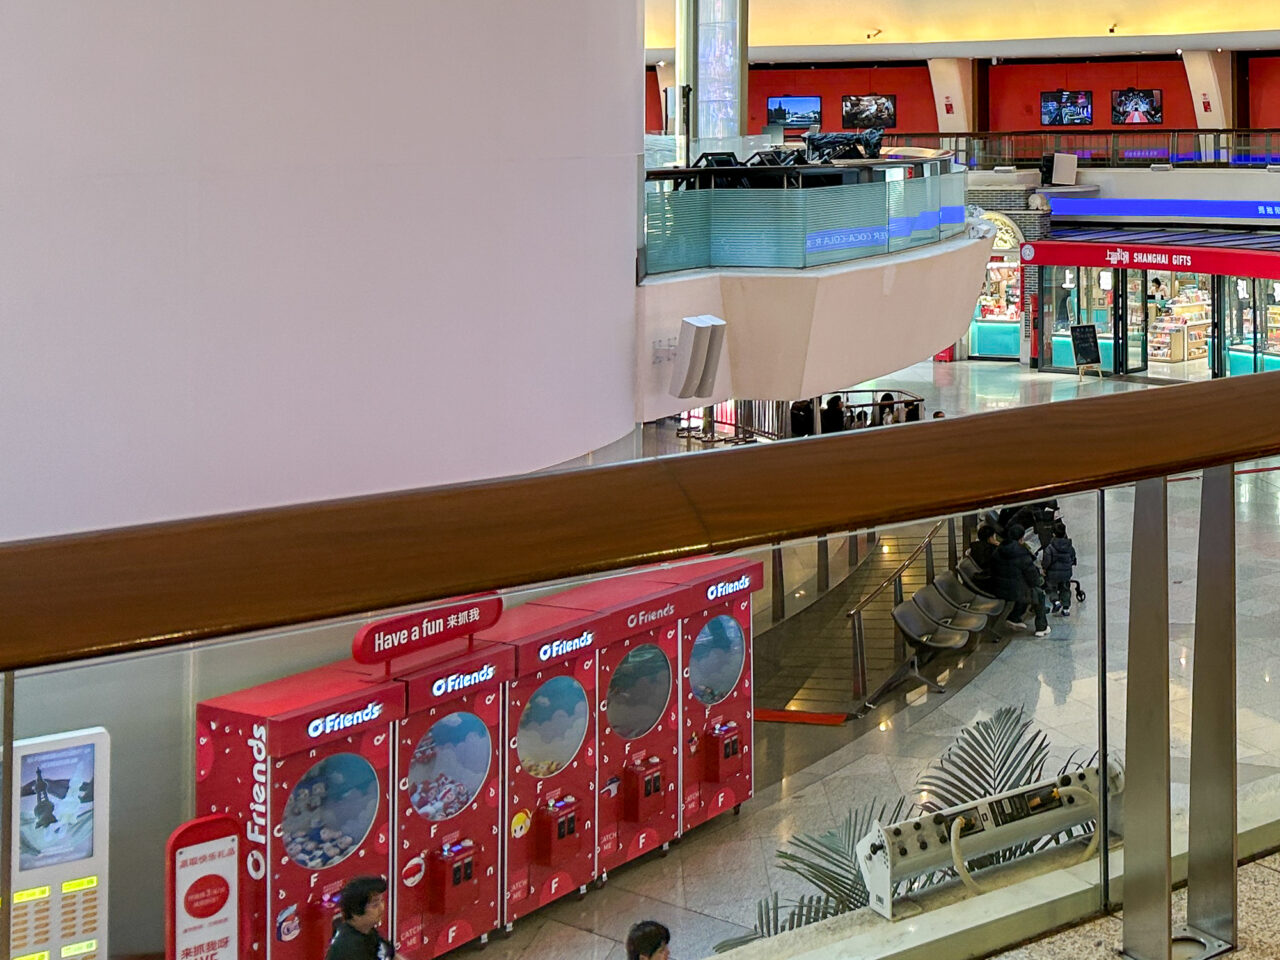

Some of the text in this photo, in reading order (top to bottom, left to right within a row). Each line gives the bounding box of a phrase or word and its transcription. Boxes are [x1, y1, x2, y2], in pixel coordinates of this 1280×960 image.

[1133, 252, 1169, 265] SHANGHAI
[1172, 254, 1192, 266] GIFTS
[374, 607, 480, 653] Have a fun 来抓我
